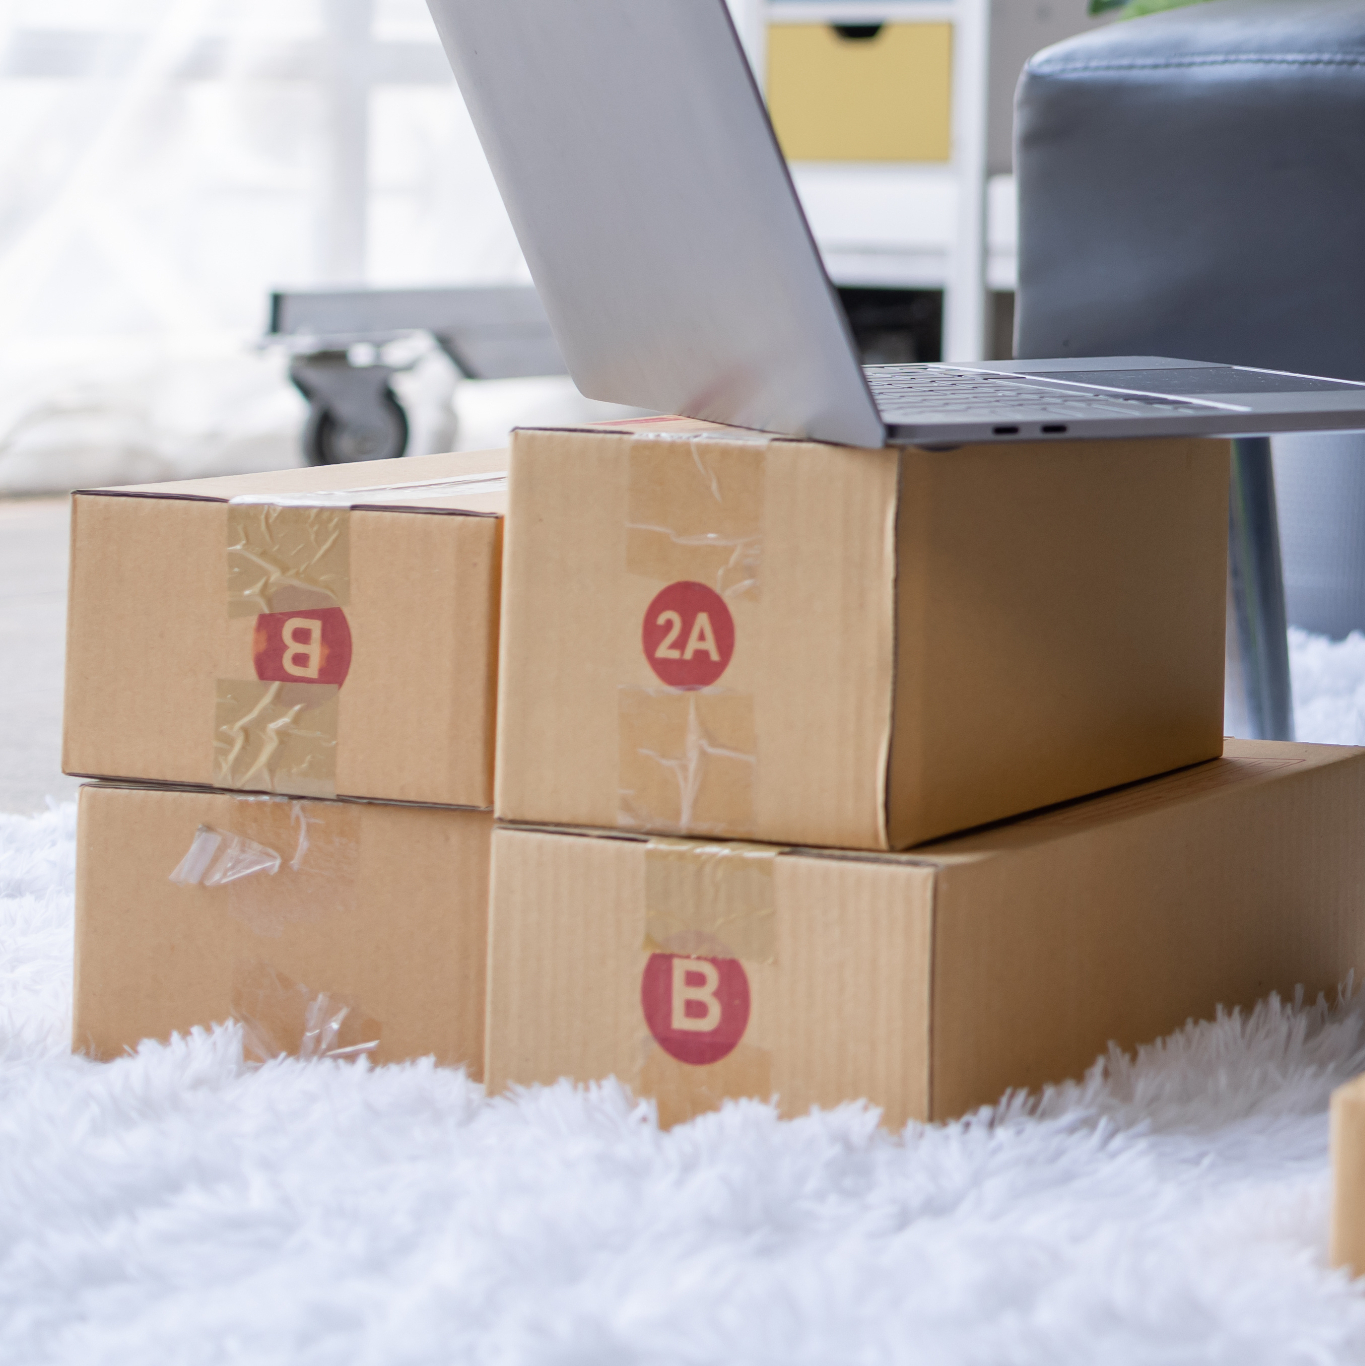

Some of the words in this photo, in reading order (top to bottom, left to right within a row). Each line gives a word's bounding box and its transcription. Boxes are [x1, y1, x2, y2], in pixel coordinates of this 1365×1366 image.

[282, 618, 322, 679] B
[655, 610, 720, 662] 2A
[670, 958, 722, 1031] B
